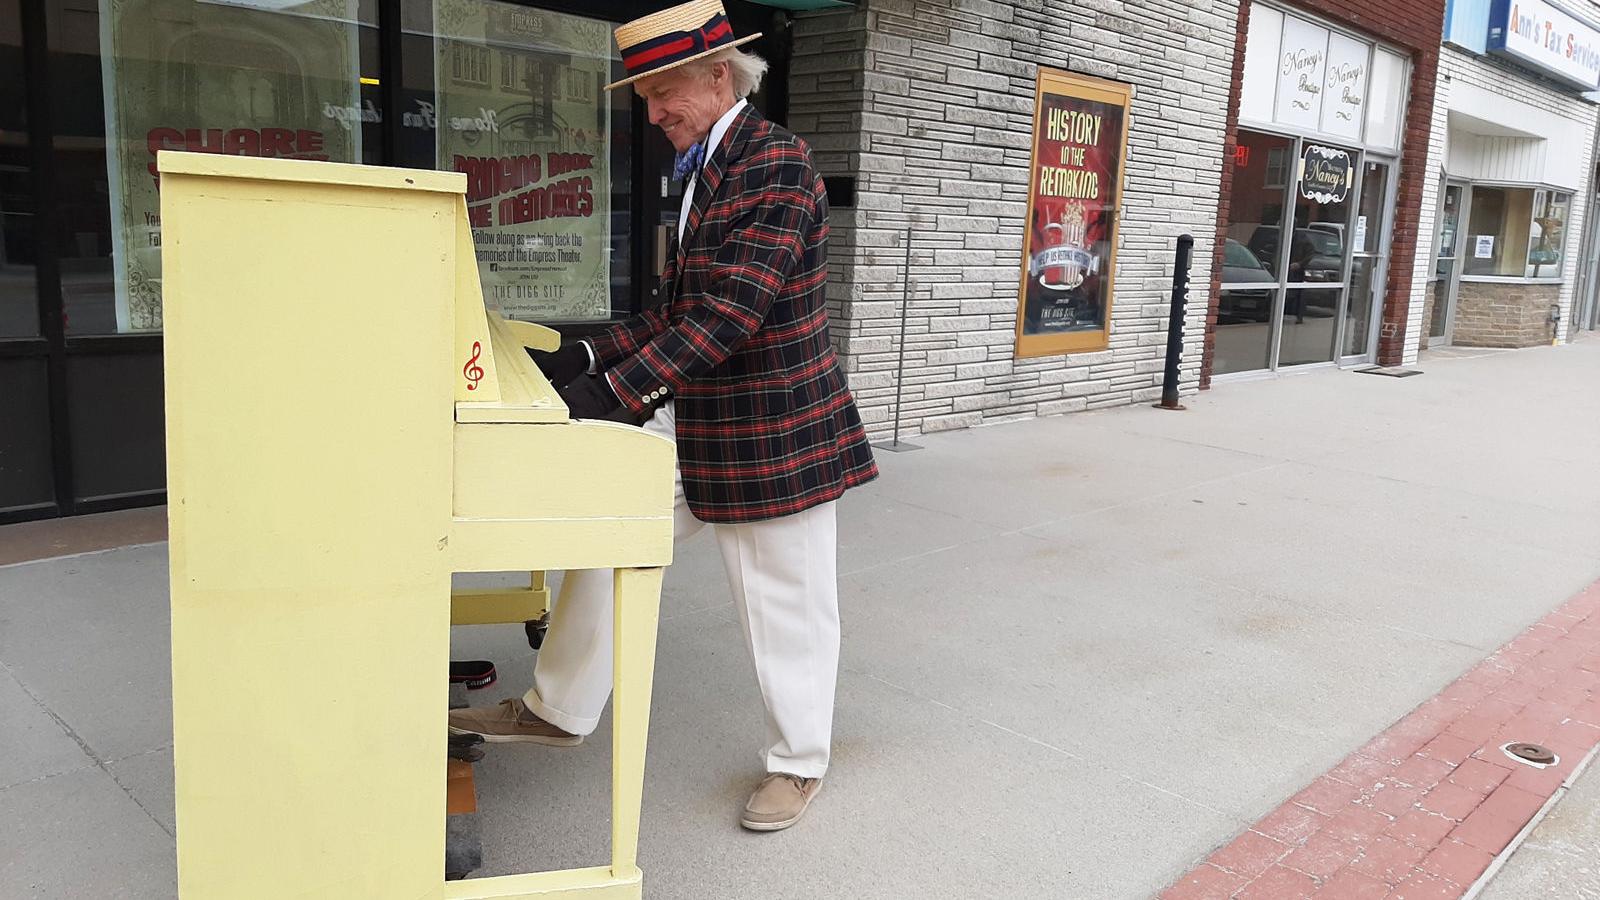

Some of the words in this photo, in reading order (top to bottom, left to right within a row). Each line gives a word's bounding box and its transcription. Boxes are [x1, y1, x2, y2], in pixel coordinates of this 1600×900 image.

[1511, 4, 1541, 44] Ann's
[1545, 21, 1562, 55] Tax
[1566, 33, 1600, 71] Service
[1283, 49, 1323, 76] Nancy's
[1328, 63, 1364, 89] Nancy's
[1047, 107, 1102, 147] HISTORY
[1071, 147, 1086, 167] THE
[1039, 166, 1099, 200] REMAKING
[1306, 159, 1345, 193] Nancy's
[498, 176, 593, 226] MEMORIES
[496, 230, 515, 247] along
[516, 233, 525, 246] as
[537, 232, 554, 248] bring
[555, 232, 571, 247] back
[571, 233, 583, 247] the
[507, 248, 515, 262] of
[516, 248, 527, 262] the
[528, 248, 556, 264] Empress
[494, 285, 512, 299] THE
[517, 285, 539, 299] DIGG
[543, 284, 564, 298] SITE
